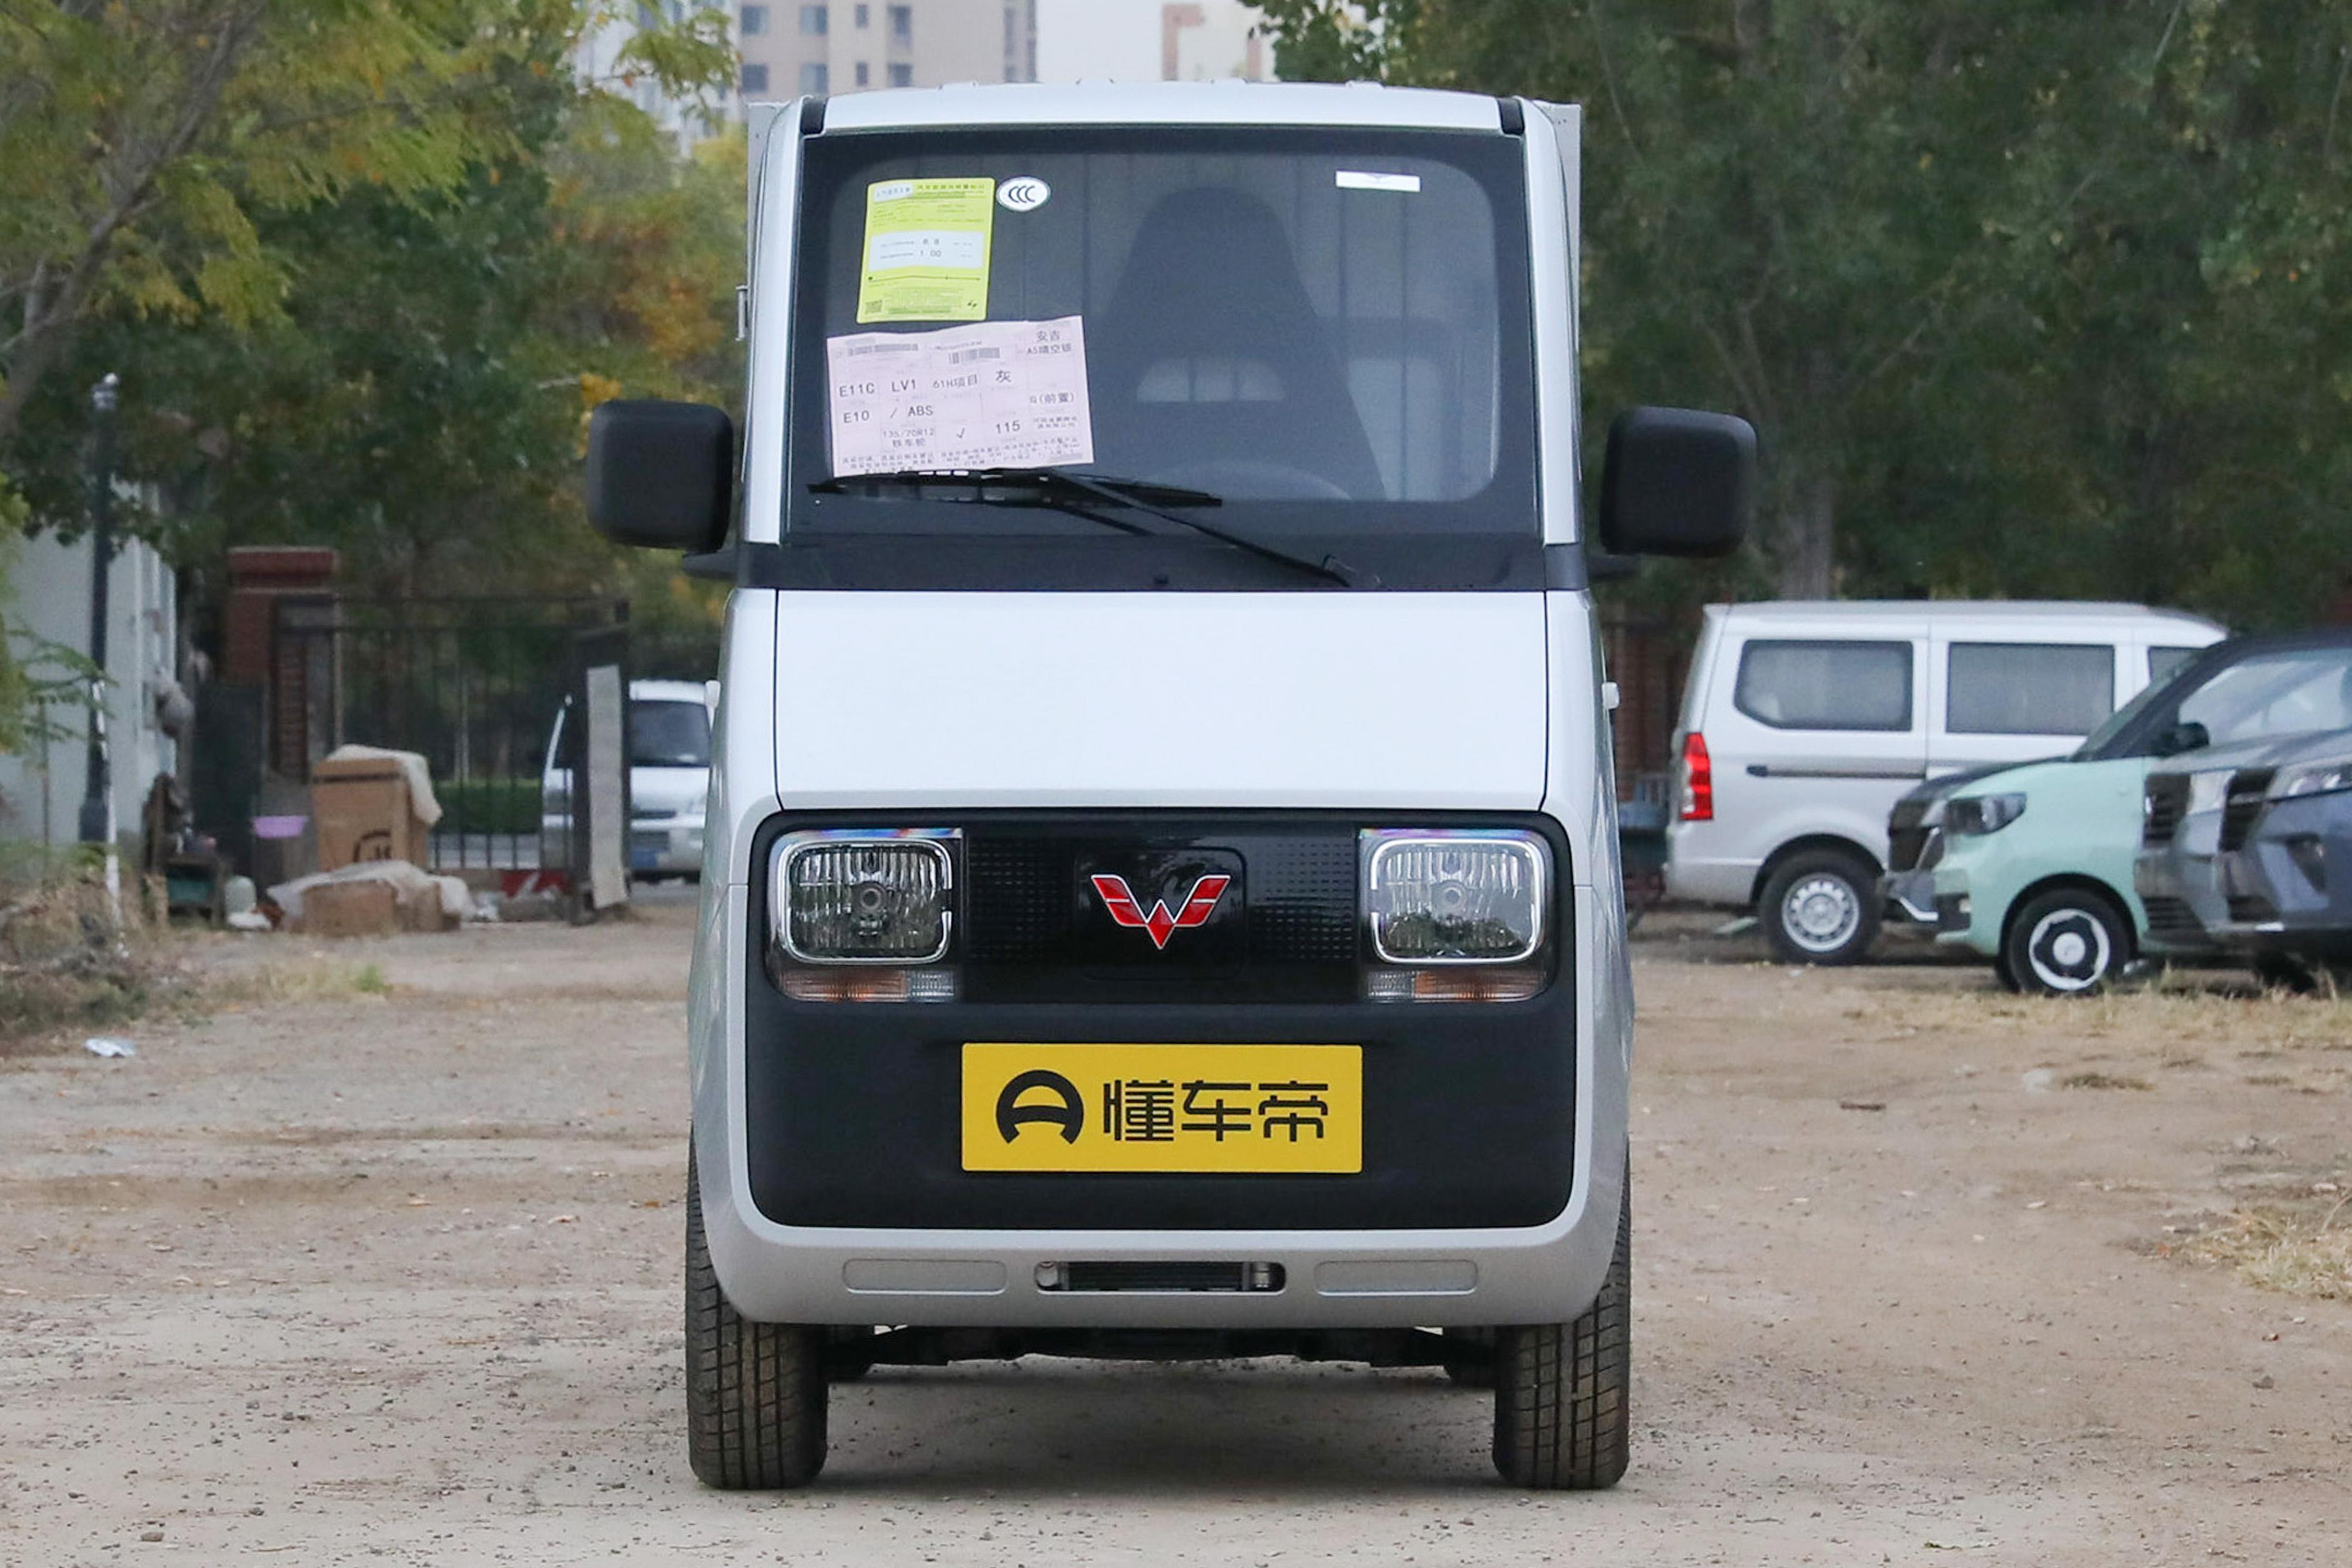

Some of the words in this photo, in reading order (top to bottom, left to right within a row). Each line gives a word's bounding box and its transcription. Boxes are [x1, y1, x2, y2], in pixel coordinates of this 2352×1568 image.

[839, 382, 875, 397] E11C
[891, 379, 916, 392] LV1
[995, 369, 1012, 383] 灰
[843, 410, 870, 423] E10
[908, 405, 934, 417] ABS
[995, 420, 1021, 435] 115
[1103, 1079, 1328, 1142] 懂车帝
